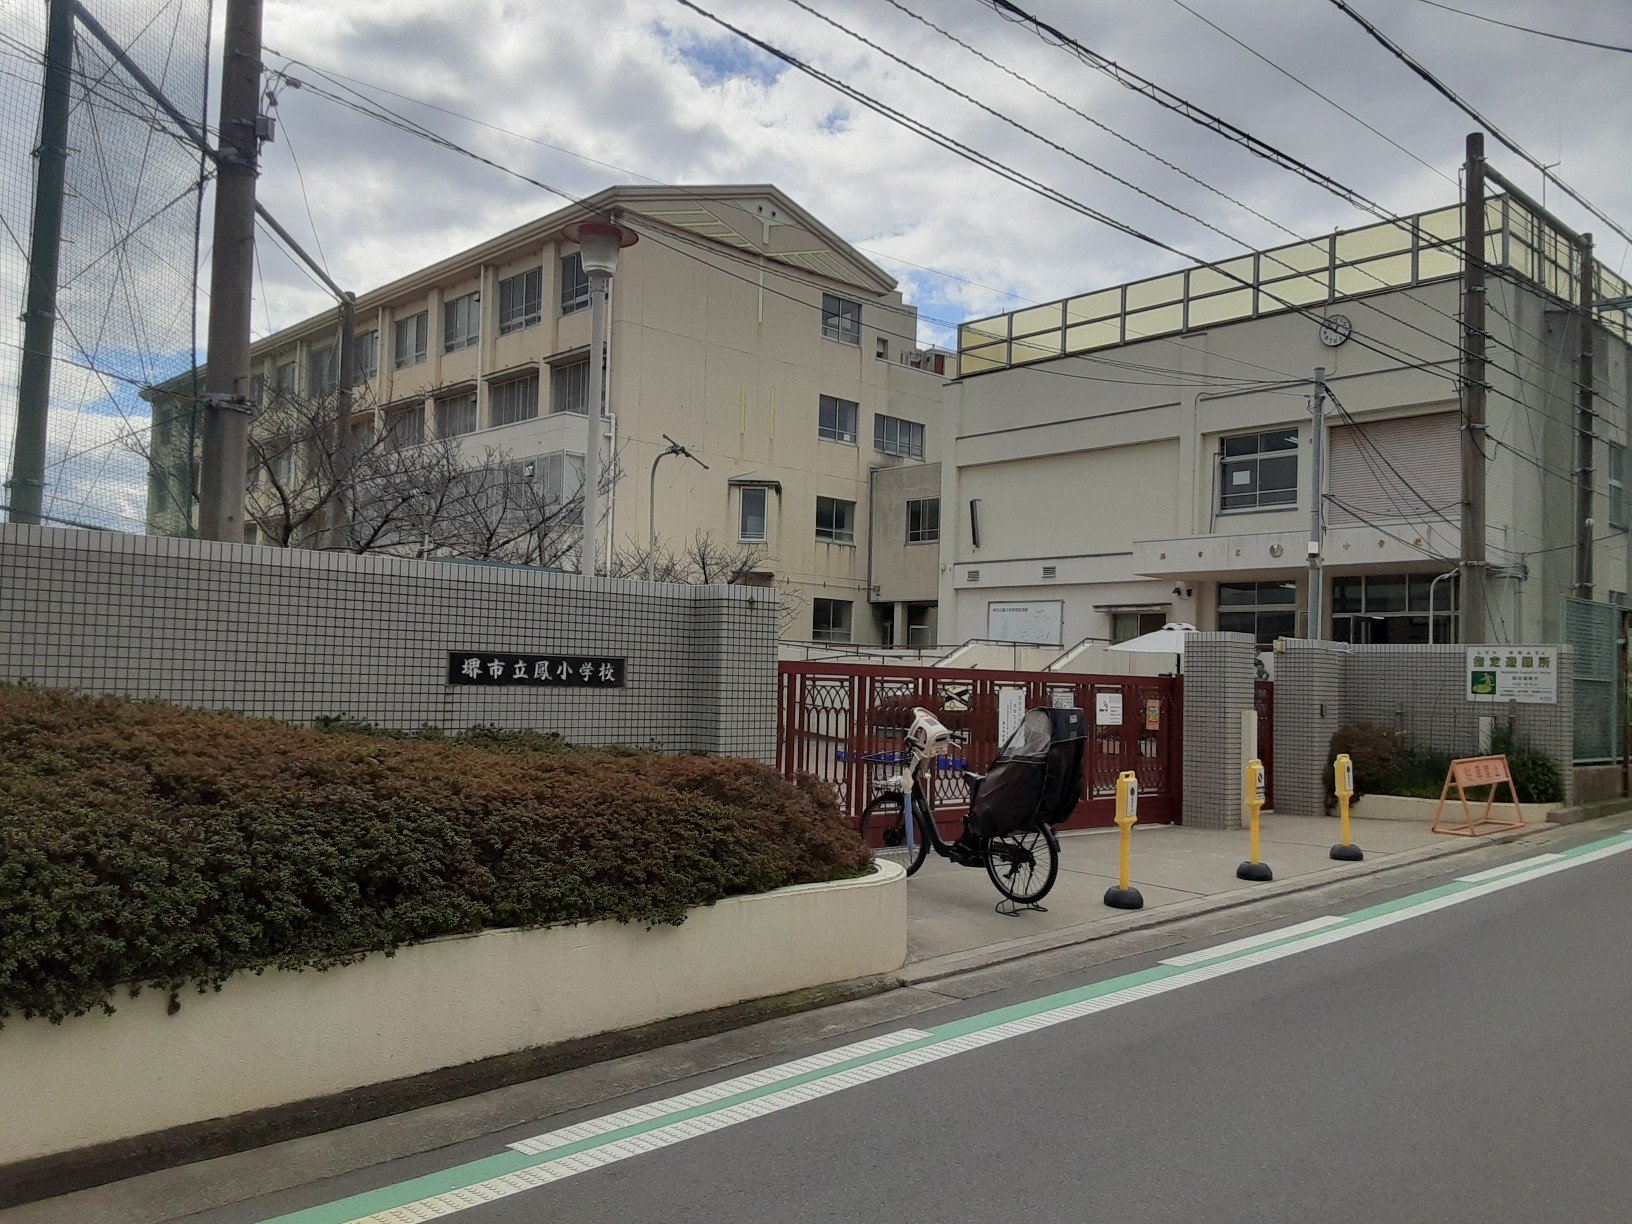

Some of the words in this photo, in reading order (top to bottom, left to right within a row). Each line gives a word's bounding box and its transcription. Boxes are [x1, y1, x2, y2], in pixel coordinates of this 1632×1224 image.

[461, 657, 616, 682] 堺市立鳳小学校
